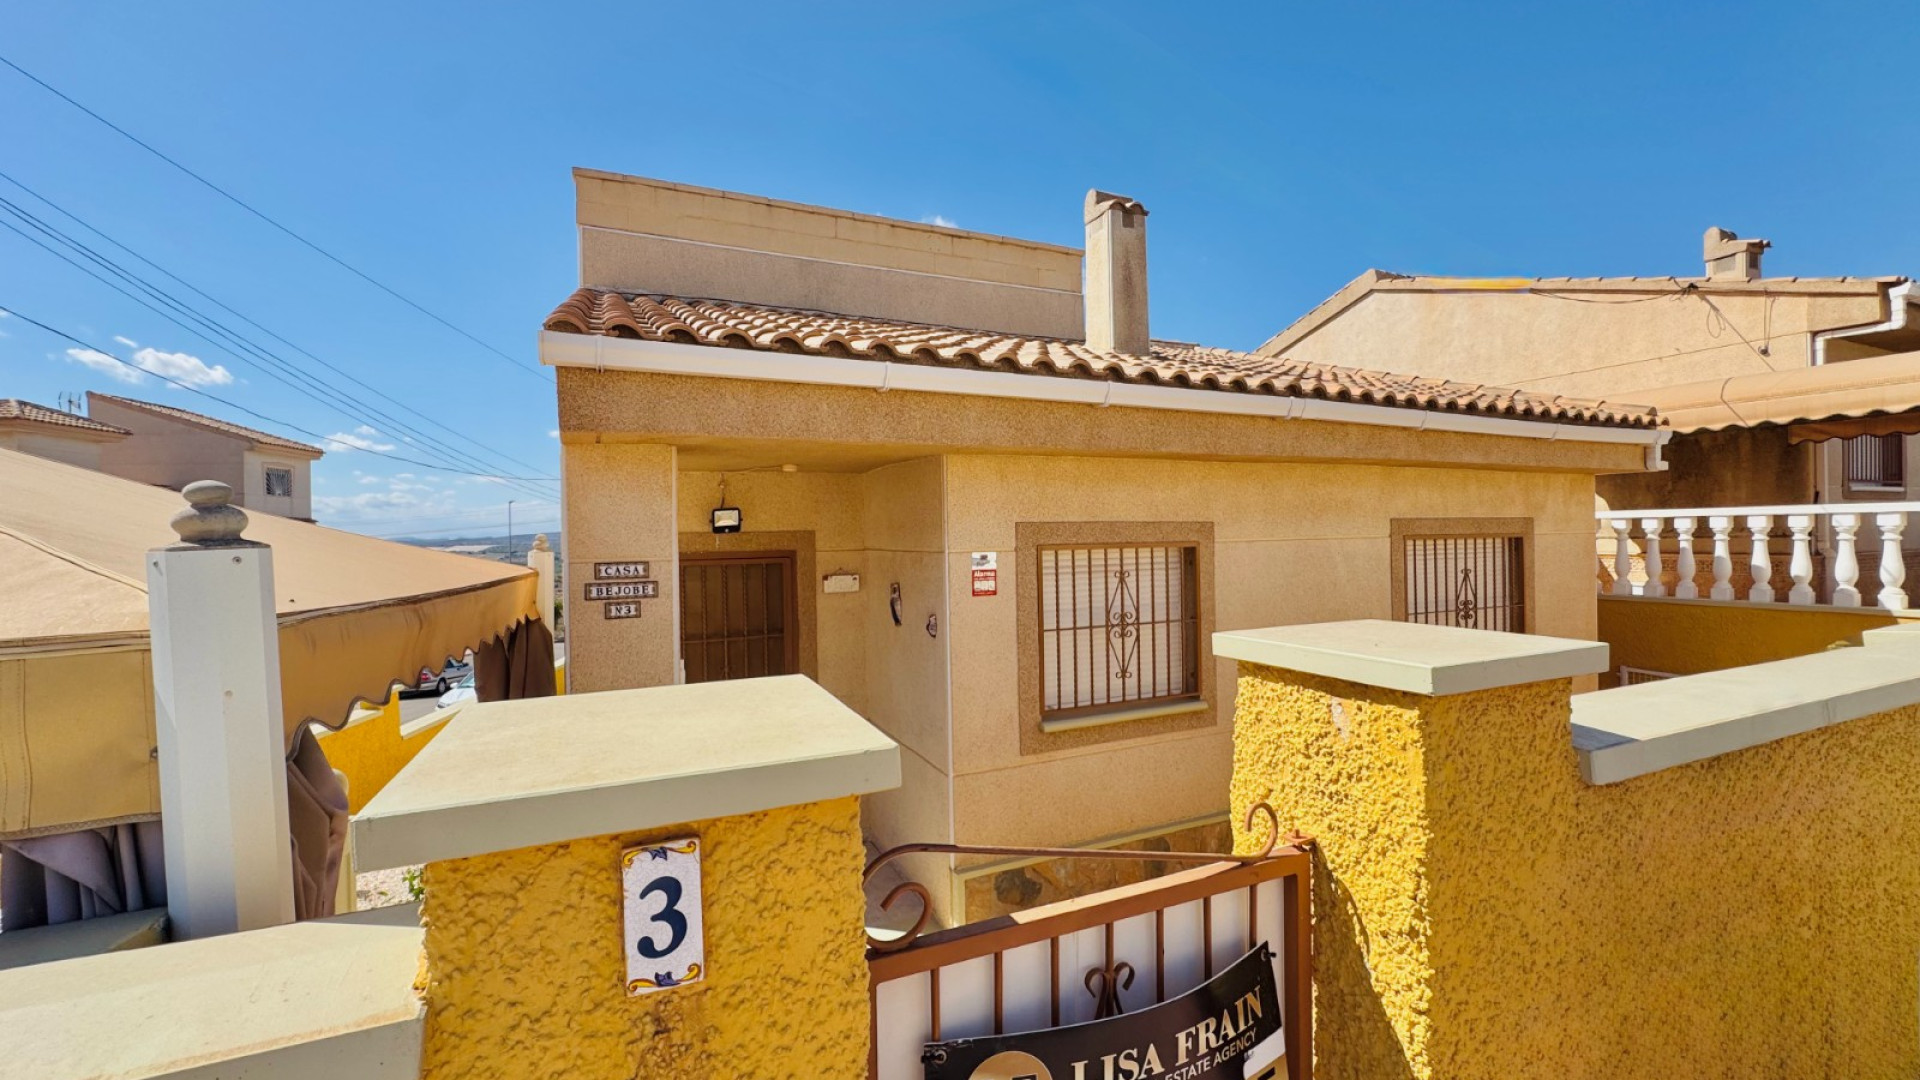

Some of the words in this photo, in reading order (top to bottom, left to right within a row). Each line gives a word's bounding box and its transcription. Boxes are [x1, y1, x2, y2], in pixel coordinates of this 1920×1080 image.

[596, 585, 650, 596] BEJOBE
[604, 565, 640, 576] CASA
[637, 876, 687, 959] 3
[1175, 986, 1263, 1067] FRAIN
[1212, 1027, 1257, 1067] AGENCY
